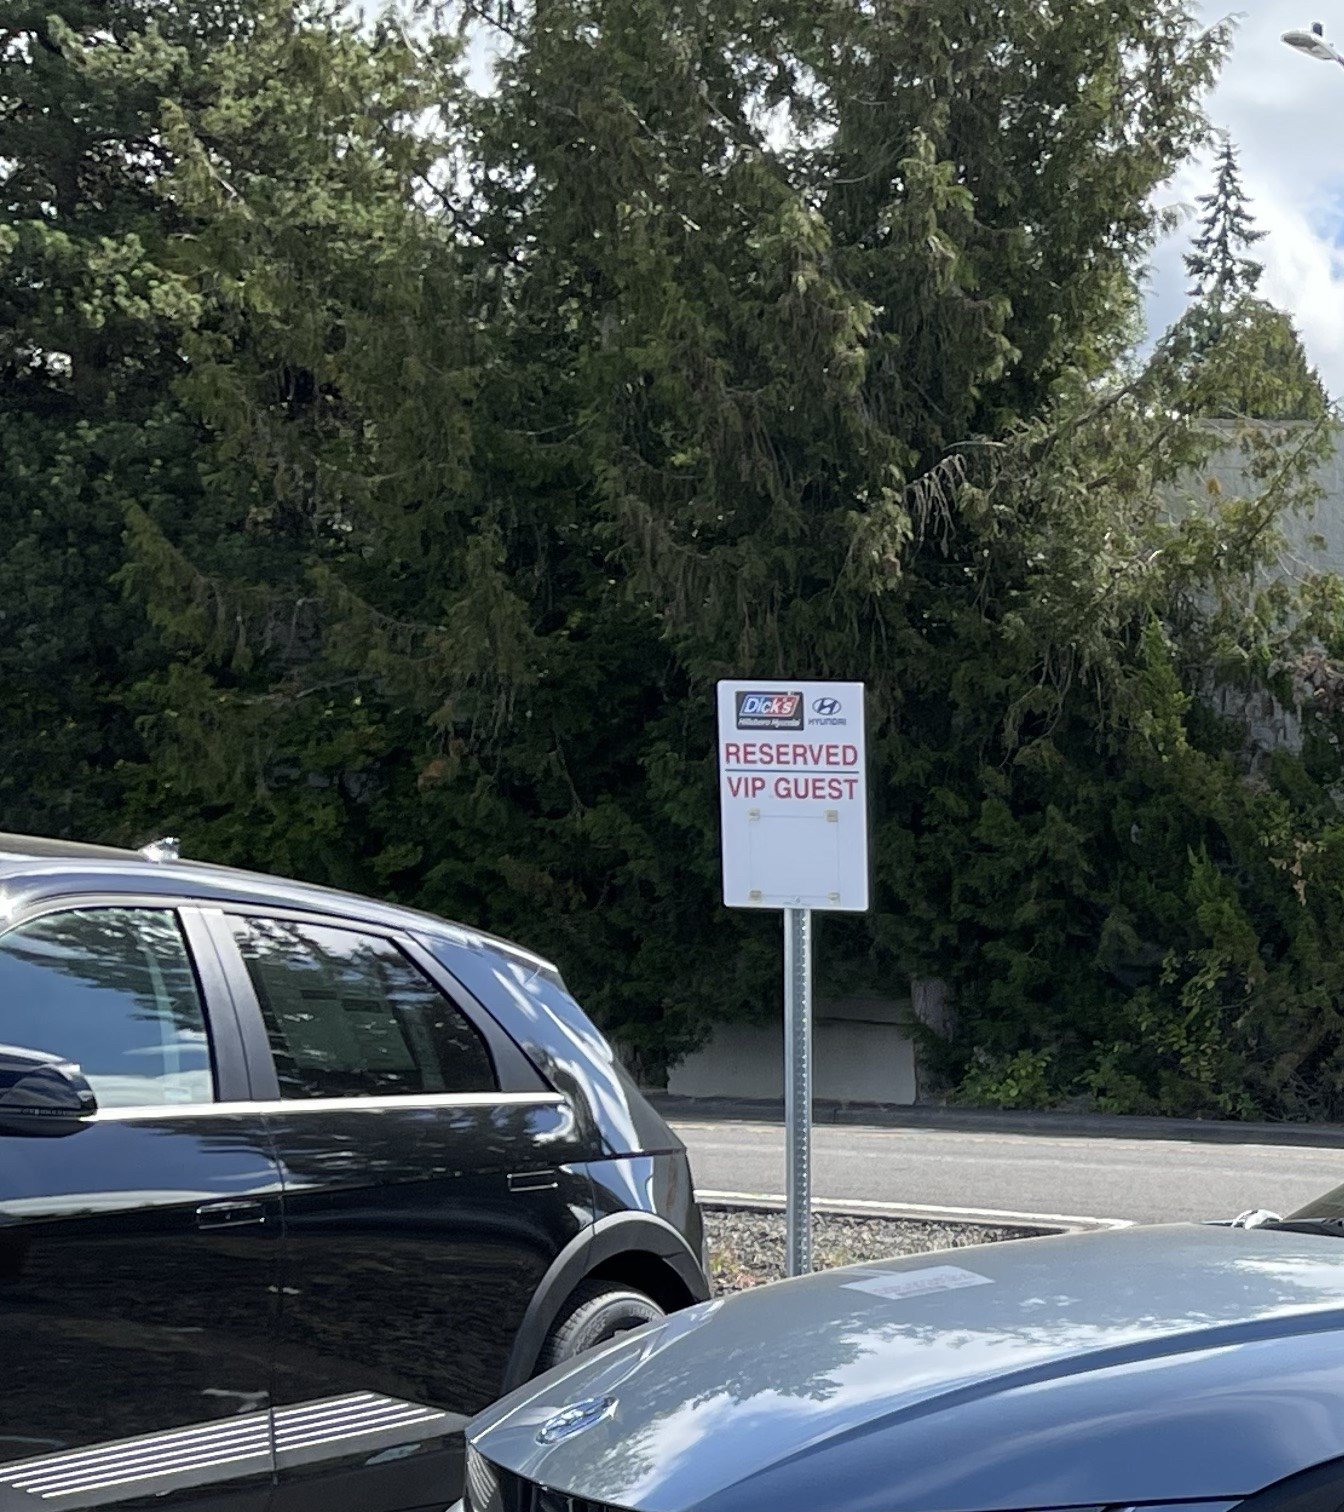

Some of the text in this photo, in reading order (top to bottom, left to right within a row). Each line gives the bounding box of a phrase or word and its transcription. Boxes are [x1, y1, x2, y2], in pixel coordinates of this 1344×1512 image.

[725, 742, 858, 766] RESERVED
[726, 776, 859, 800] VIP GUEST
